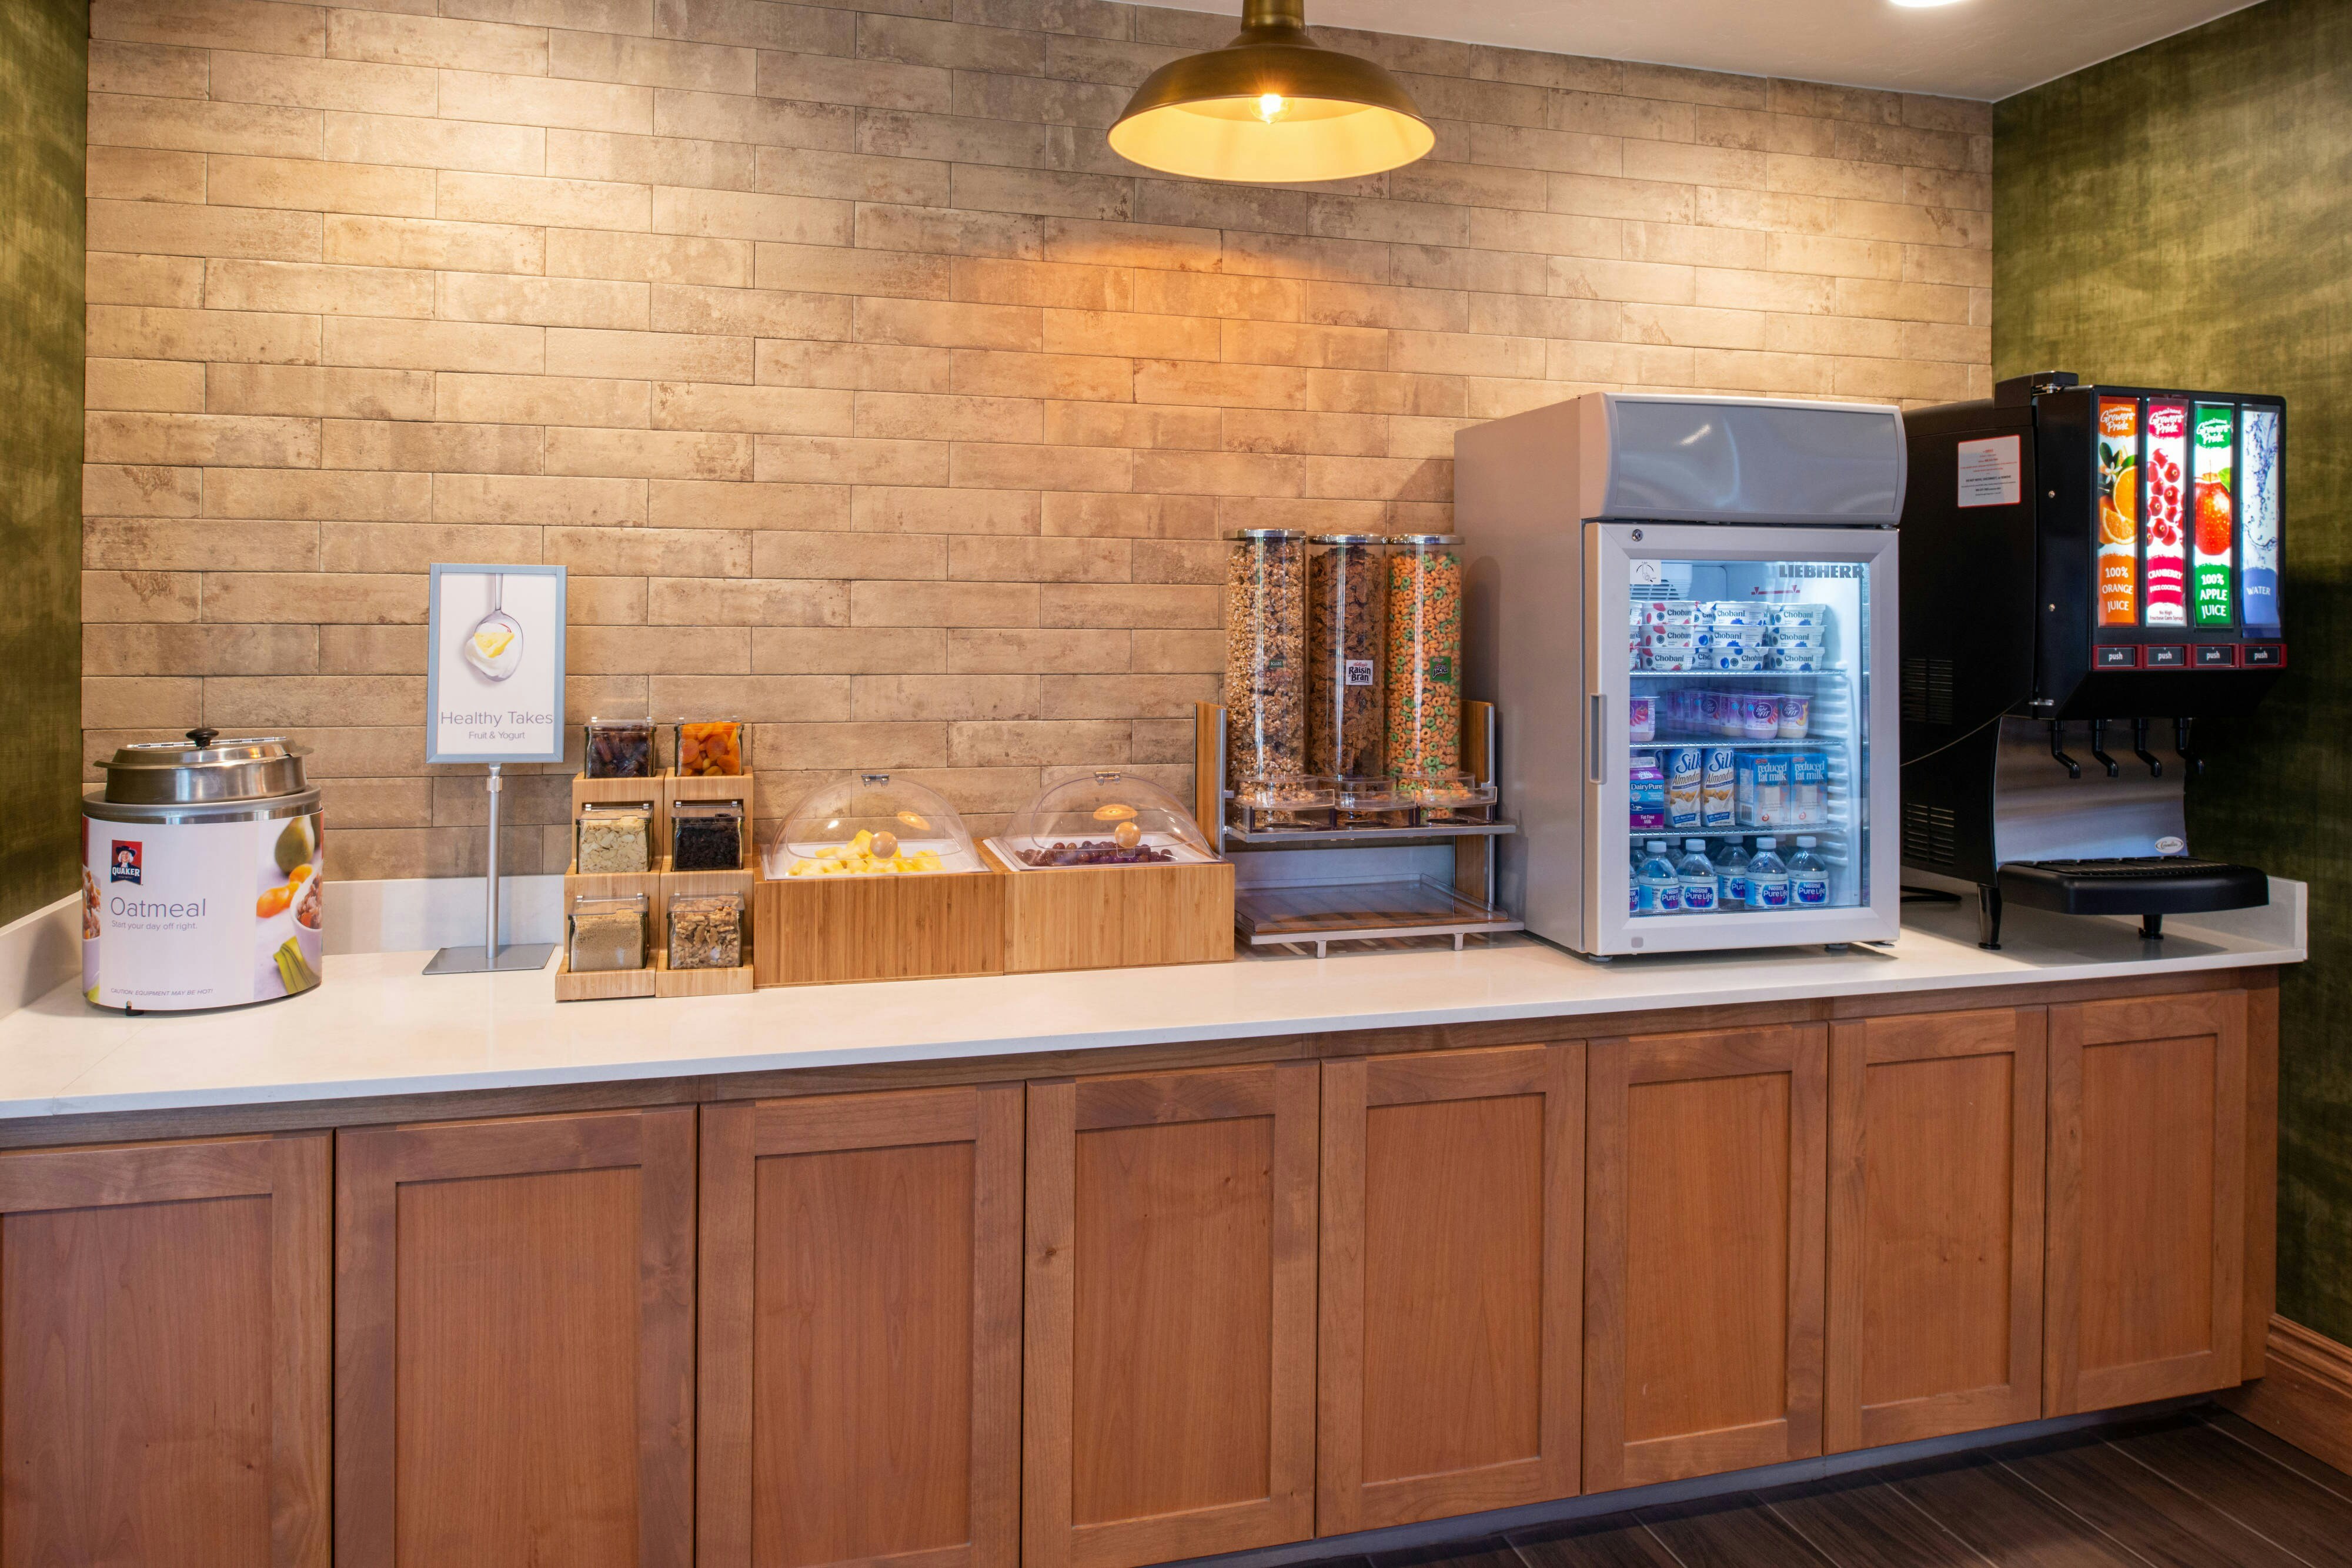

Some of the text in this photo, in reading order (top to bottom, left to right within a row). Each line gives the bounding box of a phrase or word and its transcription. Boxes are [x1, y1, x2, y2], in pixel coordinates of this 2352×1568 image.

[2107, 420, 2129, 432] Pride
[2155, 423, 2178, 434] Pride
[1779, 564, 1865, 579] LIEBHERR
[2105, 566, 2129, 578] 100%
[2148, 569, 2183, 580] CRANBERRY
[2201, 573, 2224, 585] 100%
[2102, 584, 2133, 594] ORANGE
[2246, 586, 2271, 596] WATER
[2200, 589, 2228, 601] APPLE
[2107, 600, 2129, 613] JUICE
[2201, 604, 2226, 619] JUICE
[2109, 651, 2123, 662] push
[2158, 651, 2172, 661] push
[2206, 650, 2220, 661] push
[2254, 650, 2268, 660] push
[1348, 666, 1371, 675] Raisin
[441, 711, 553, 727] Healthy Takes
[499, 731, 525, 741] Yogurt
[1675, 753, 1701, 773] Silk
[1758, 762, 1787, 773] reduced
[1795, 760, 1825, 771] reduced
[1758, 770, 1787, 782] fat milk
[1795, 769, 1824, 780] fat milk
[112, 867, 140, 877] QUAKER
[1703, 892, 1713, 901] Life
[1780, 890, 1788, 899] Life
[1816, 887, 1825, 897] Life
[111, 897, 206, 917] Oatmeal
[128, 922, 144, 930] your
[146, 922, 161, 931] day
[176, 922, 197, 931] right.
